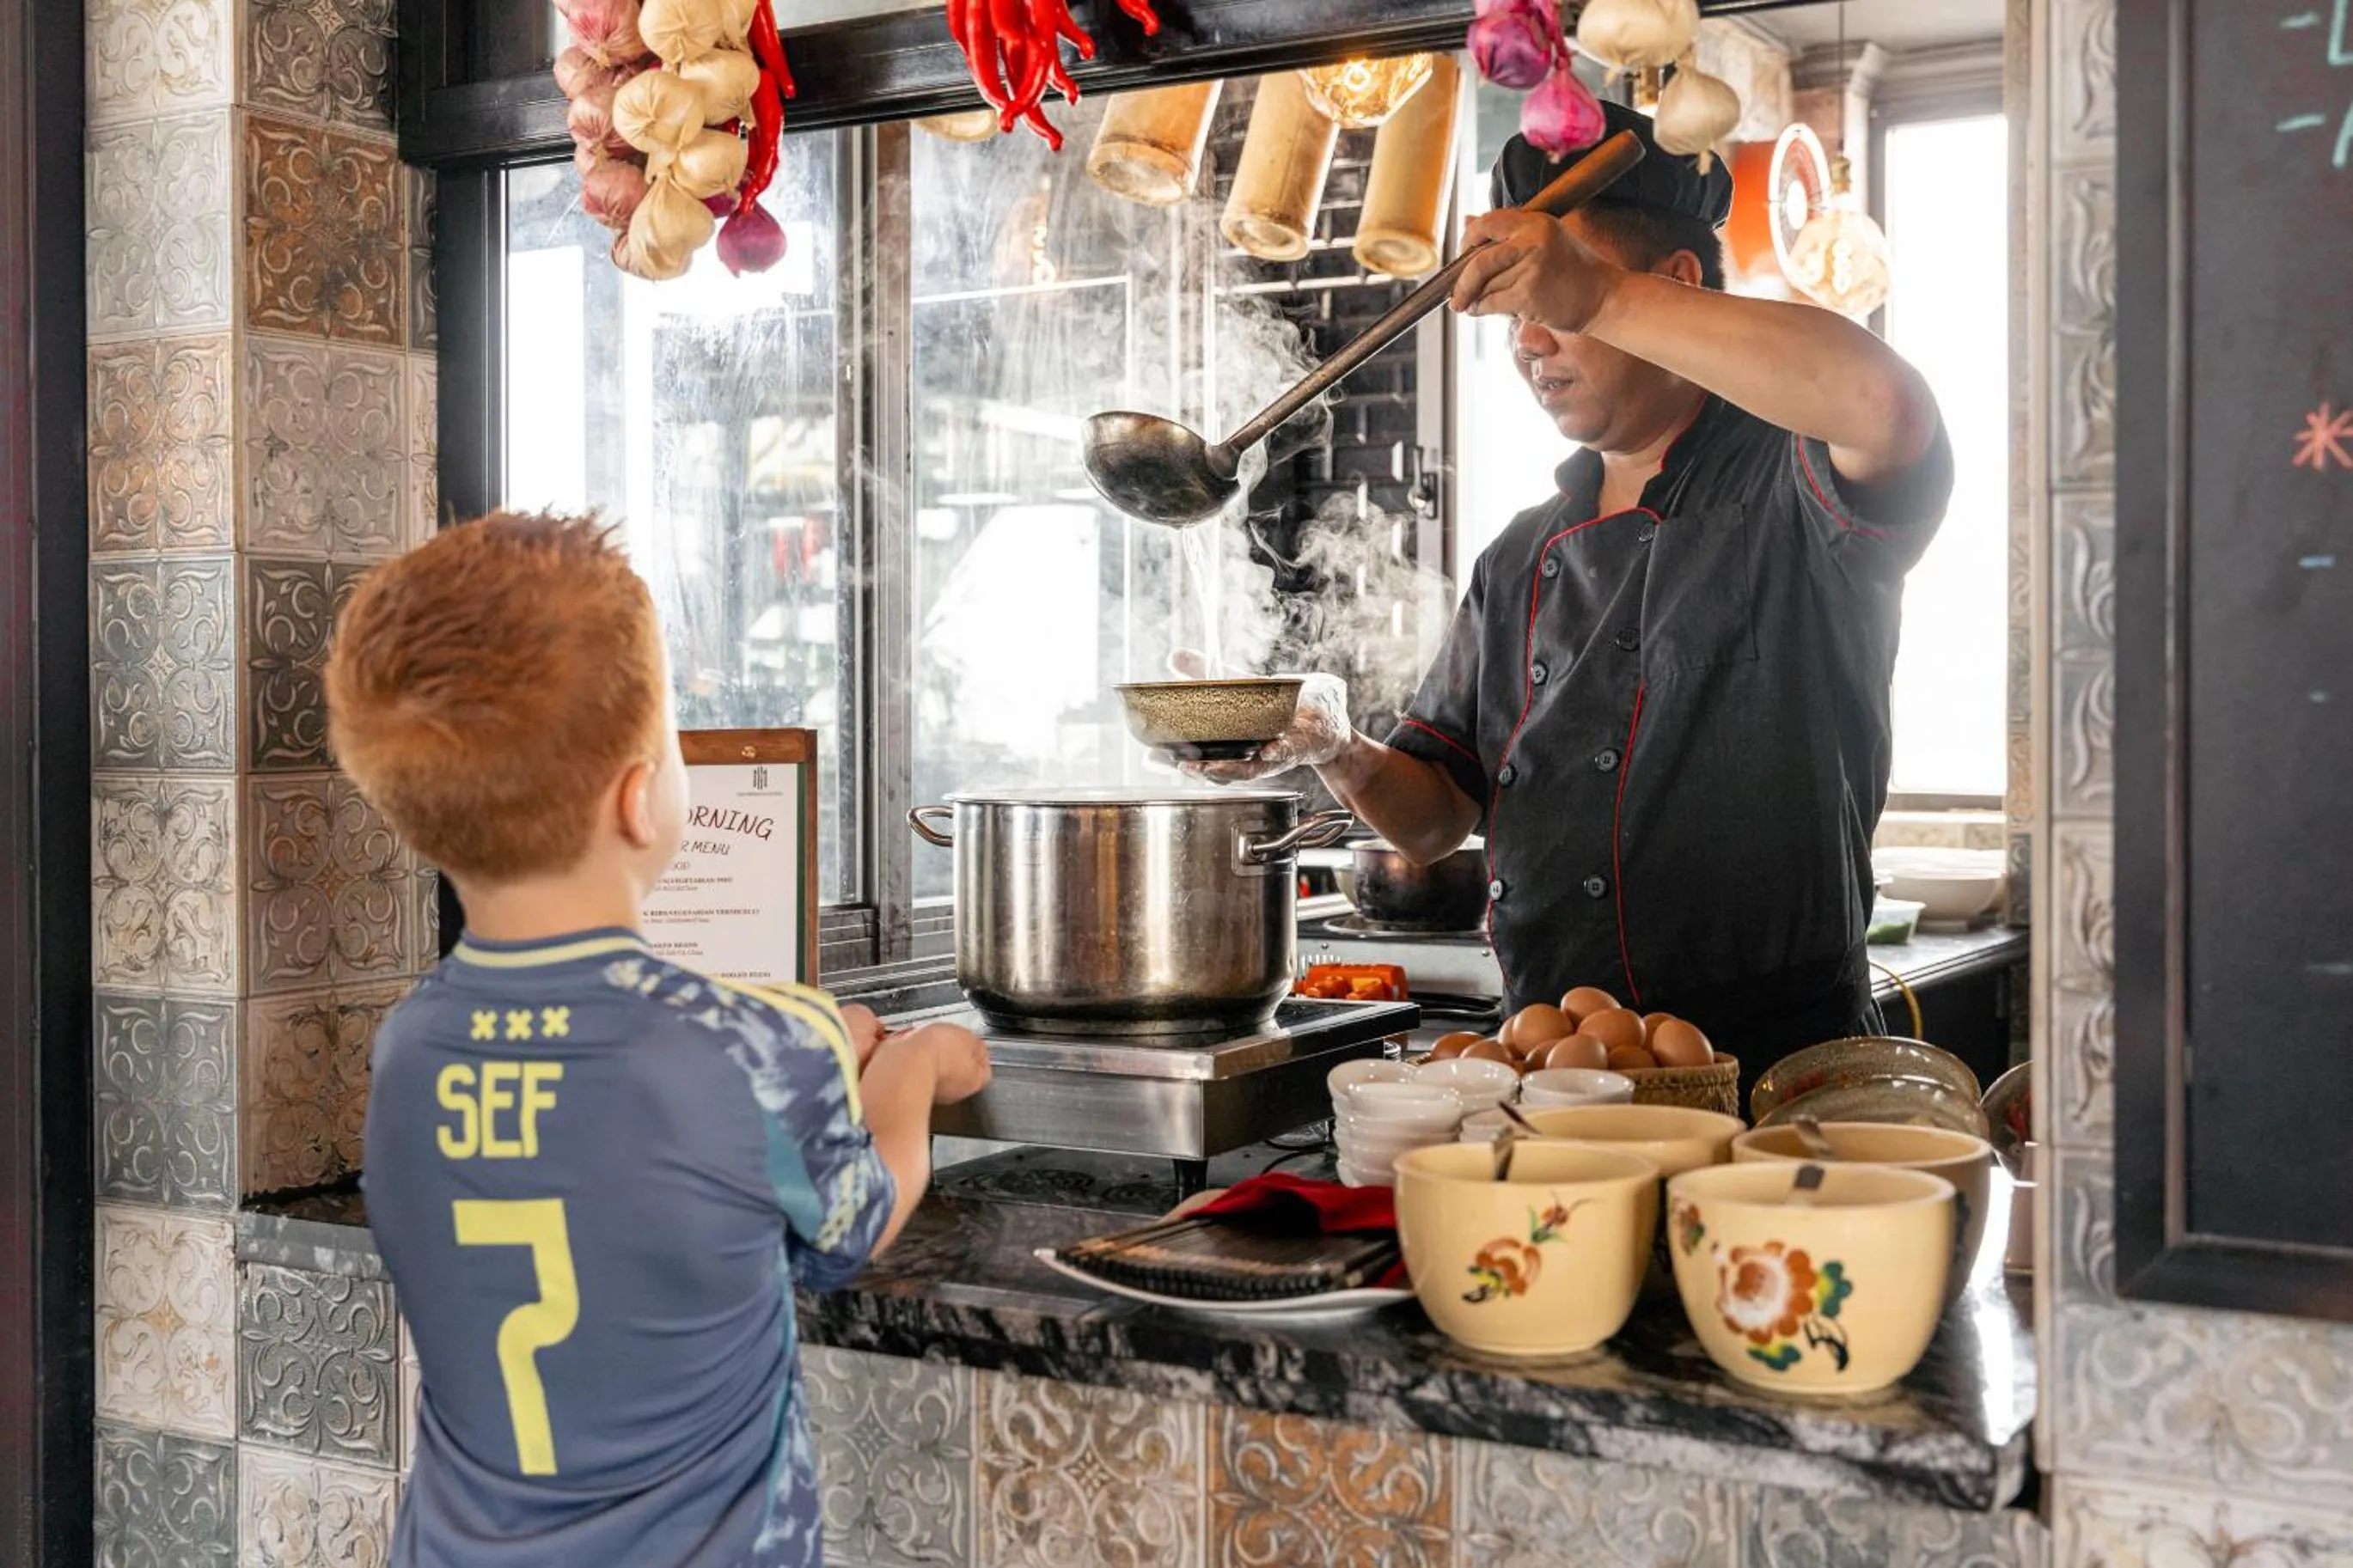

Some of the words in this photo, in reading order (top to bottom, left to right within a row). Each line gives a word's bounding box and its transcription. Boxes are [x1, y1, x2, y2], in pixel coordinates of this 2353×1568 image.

[691, 840, 730, 856] MENU
[436, 1060, 564, 1160] SEF
[452, 1198, 579, 1475] 7
